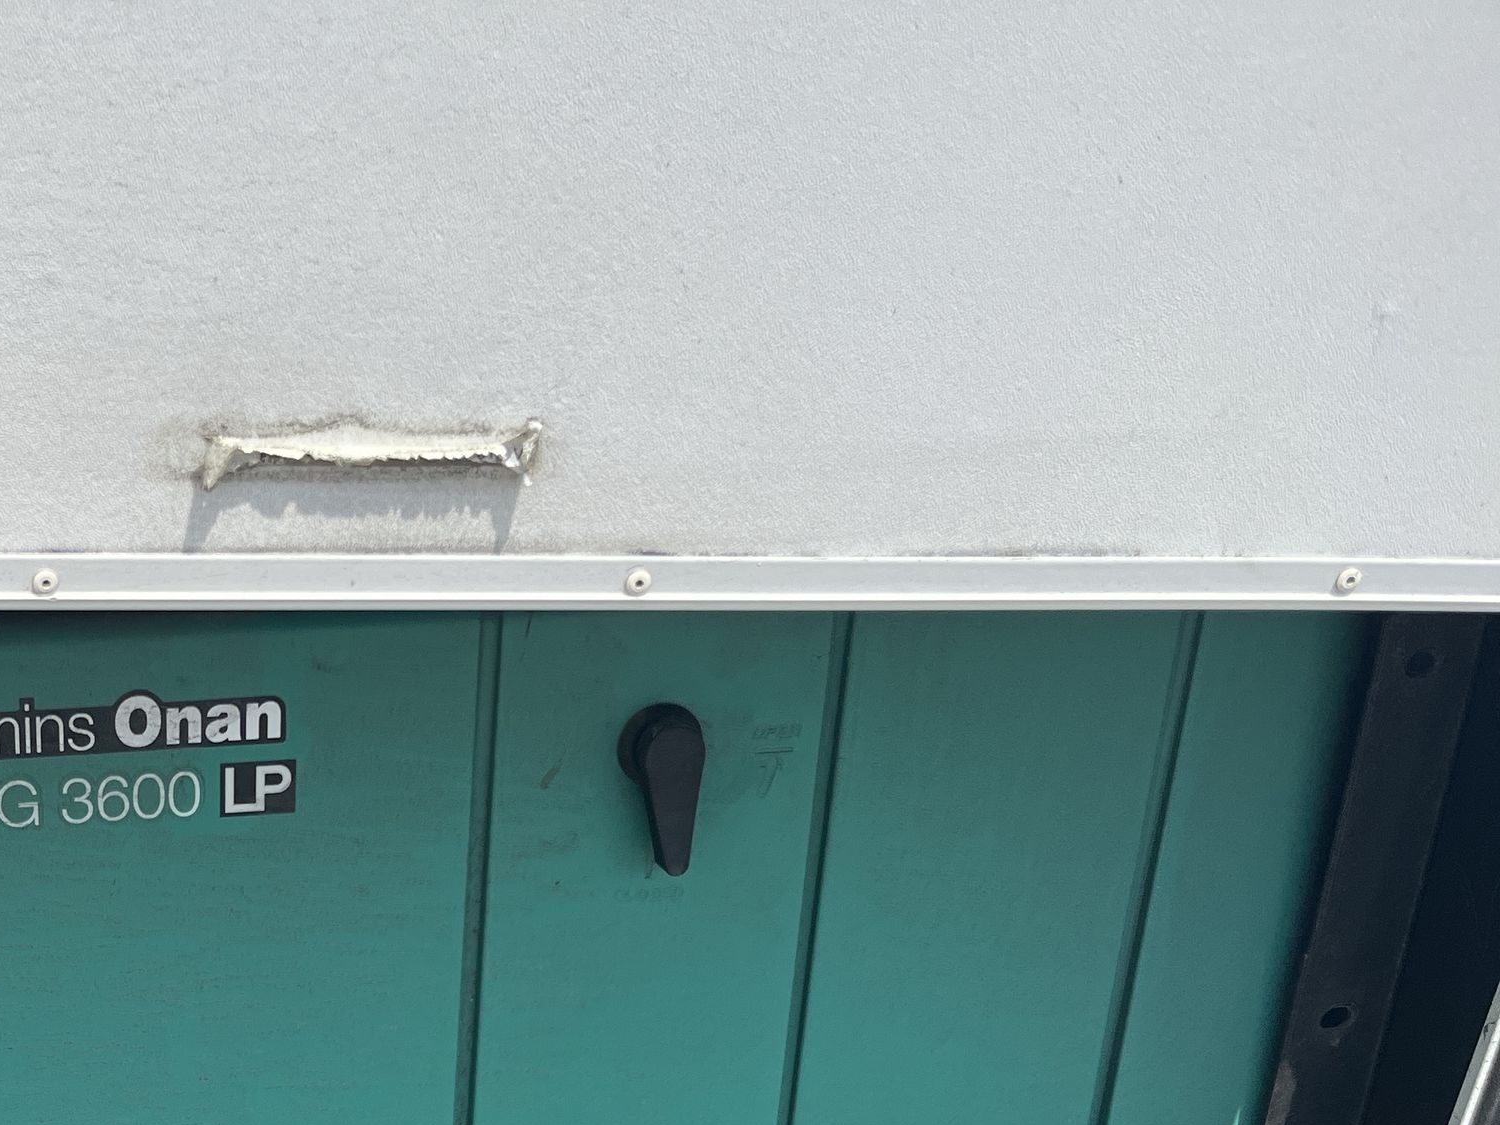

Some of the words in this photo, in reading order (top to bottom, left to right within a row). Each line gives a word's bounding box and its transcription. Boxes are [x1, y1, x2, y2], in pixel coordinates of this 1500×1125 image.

[114, 693, 282, 748] Onan
[61, 771, 201, 825] 3600
[224, 764, 292, 814] LP
